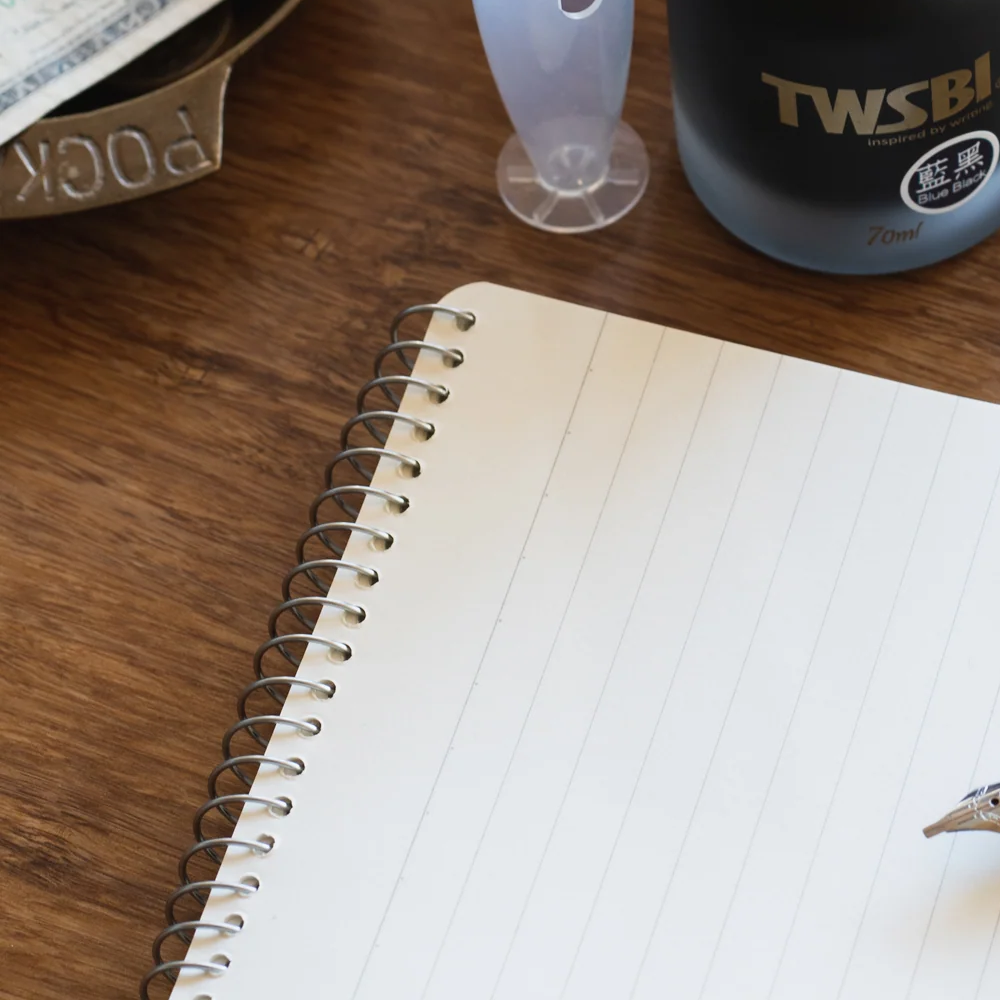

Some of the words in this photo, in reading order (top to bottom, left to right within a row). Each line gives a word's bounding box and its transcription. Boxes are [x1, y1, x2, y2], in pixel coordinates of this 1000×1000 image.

[761, 51, 992, 135] TWSBI
[867, 129, 926, 147] inspired
[930, 124, 947, 137] by
[916, 141, 985, 194] 藍黑
[917, 188, 950, 205] Blue
[952, 169, 988, 193] Black
[866, 220, 924, 246] 70ml
